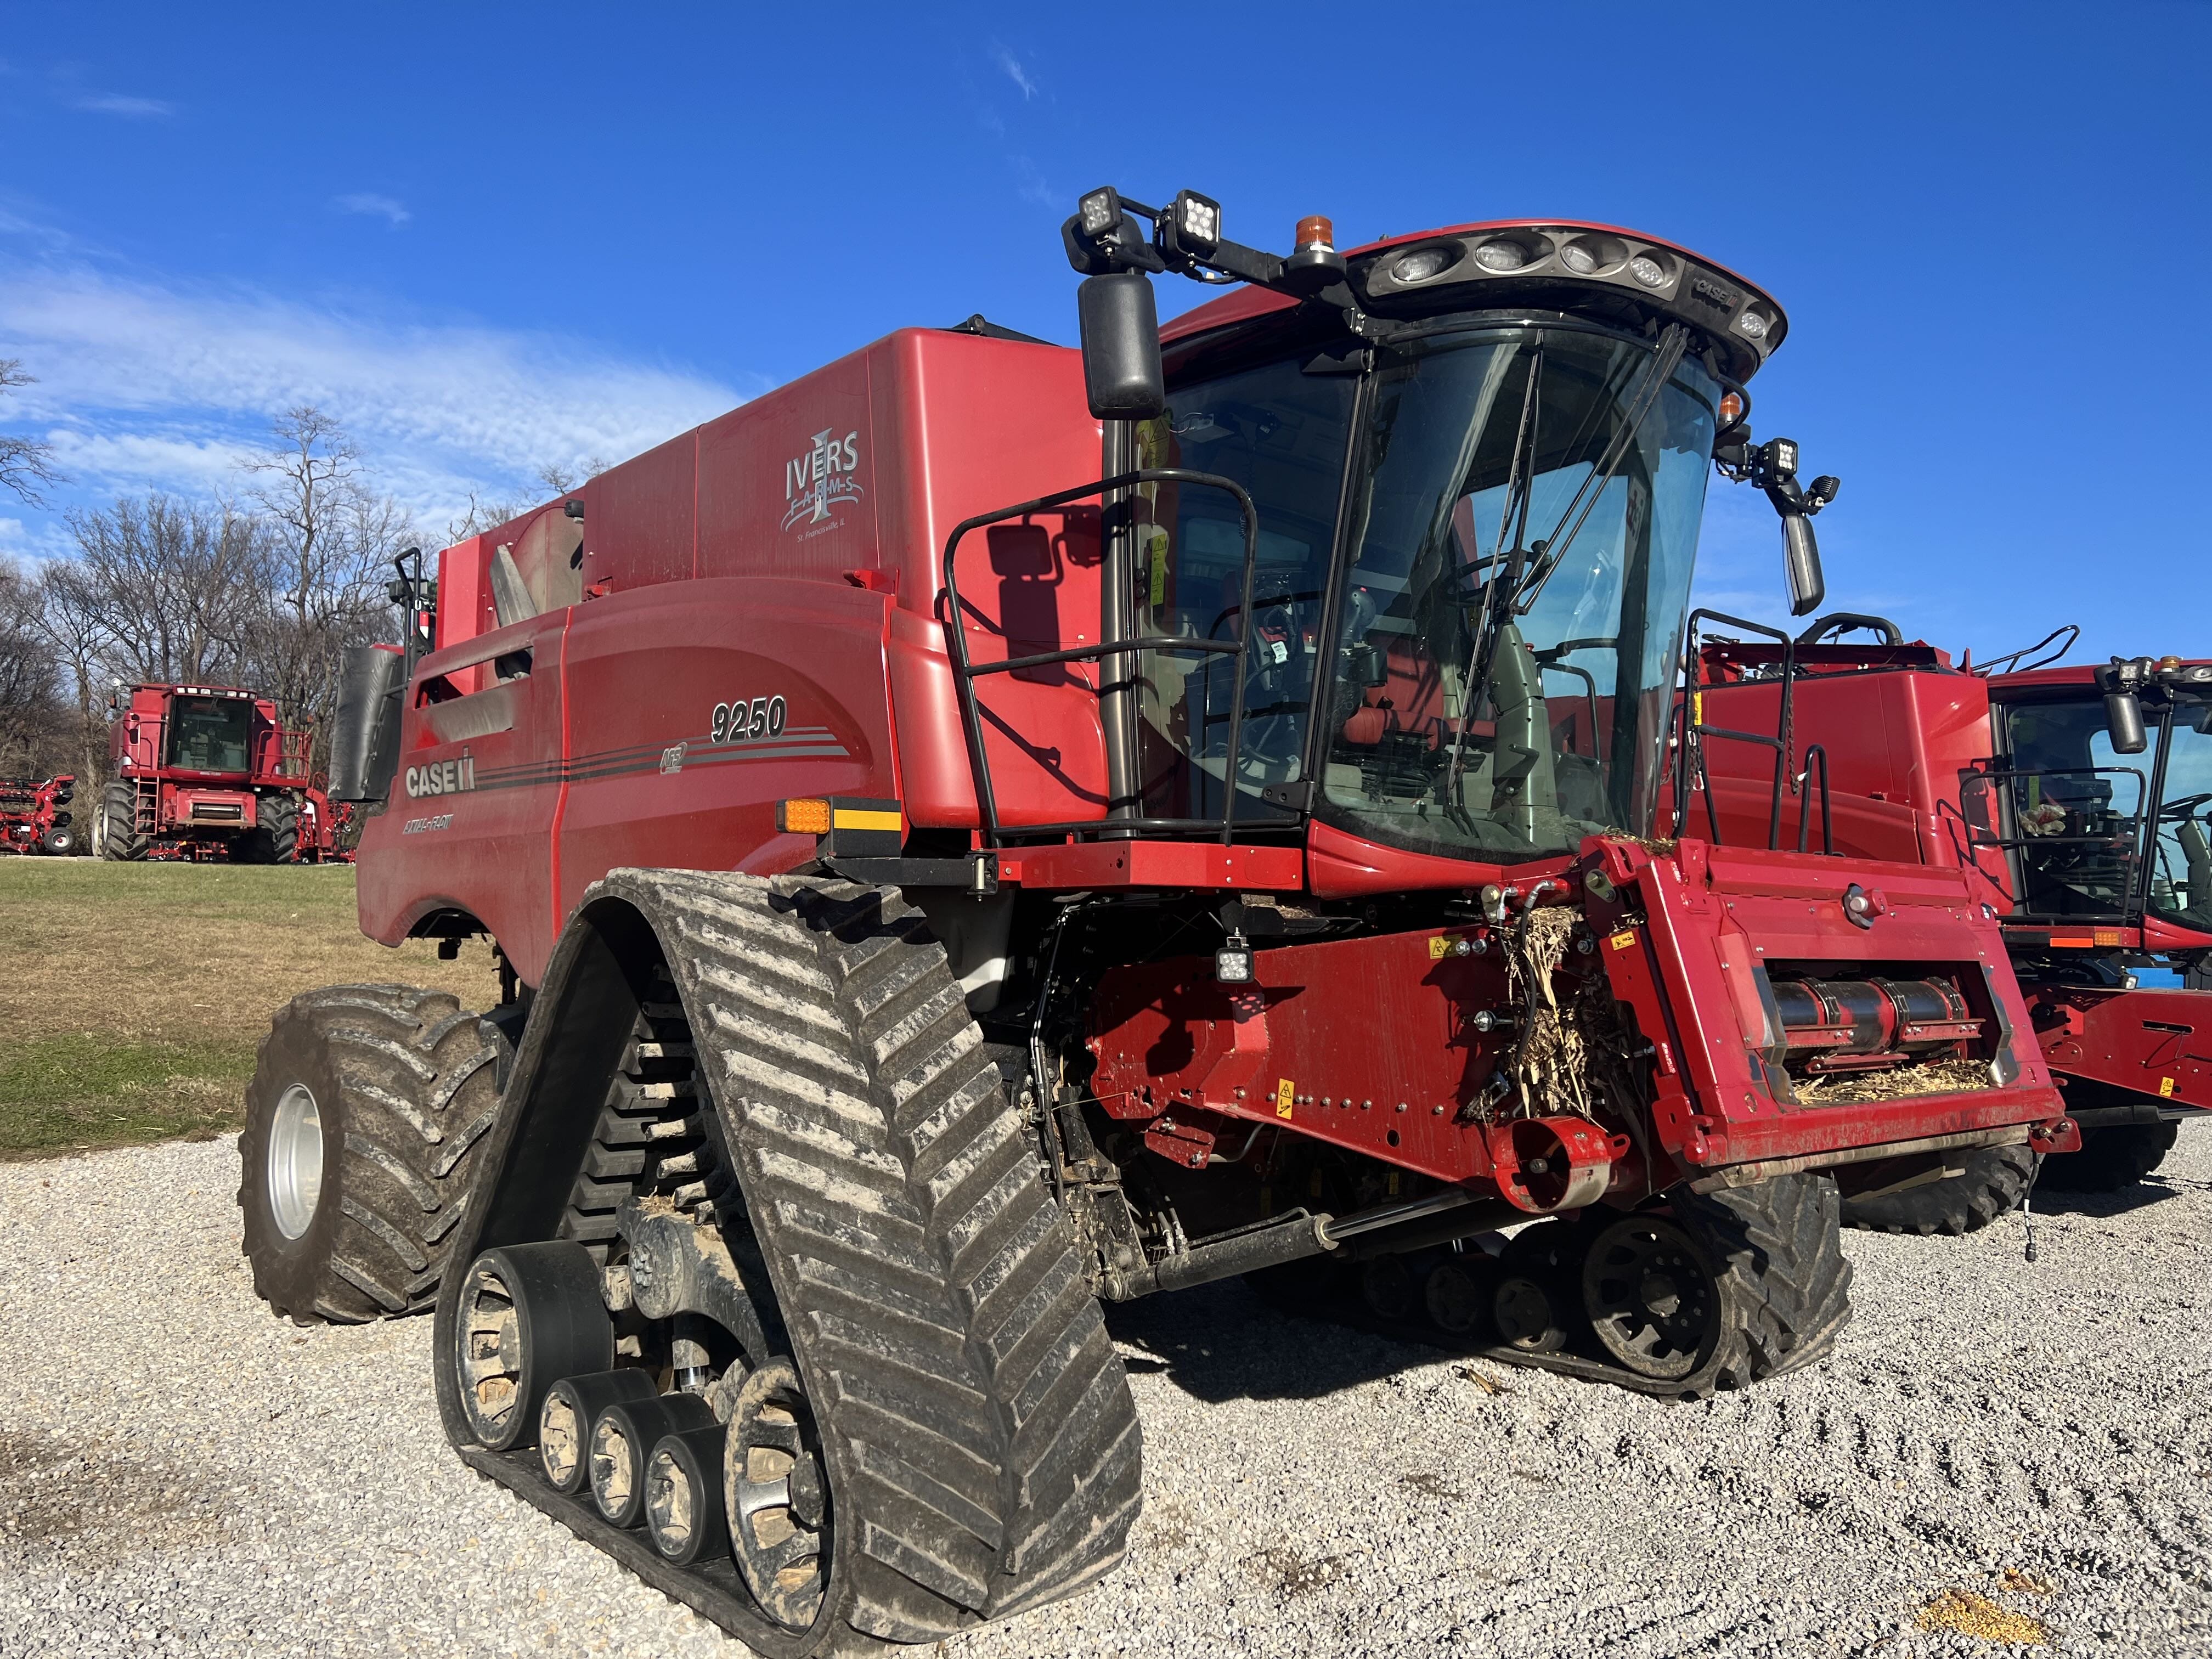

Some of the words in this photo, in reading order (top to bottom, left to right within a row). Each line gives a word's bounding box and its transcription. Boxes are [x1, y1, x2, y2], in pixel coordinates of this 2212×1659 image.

[1696, 280, 1728, 302] CASE
[786, 431, 859, 500] IVERS
[789, 476, 853, 516] FARMS
[805, 521, 839, 540] Francisville,
[839, 517, 845, 527] IL
[711, 695, 787, 745] 9250
[406, 761, 456, 797] CASE
[403, 814, 454, 835] AXIAL-FLOW
